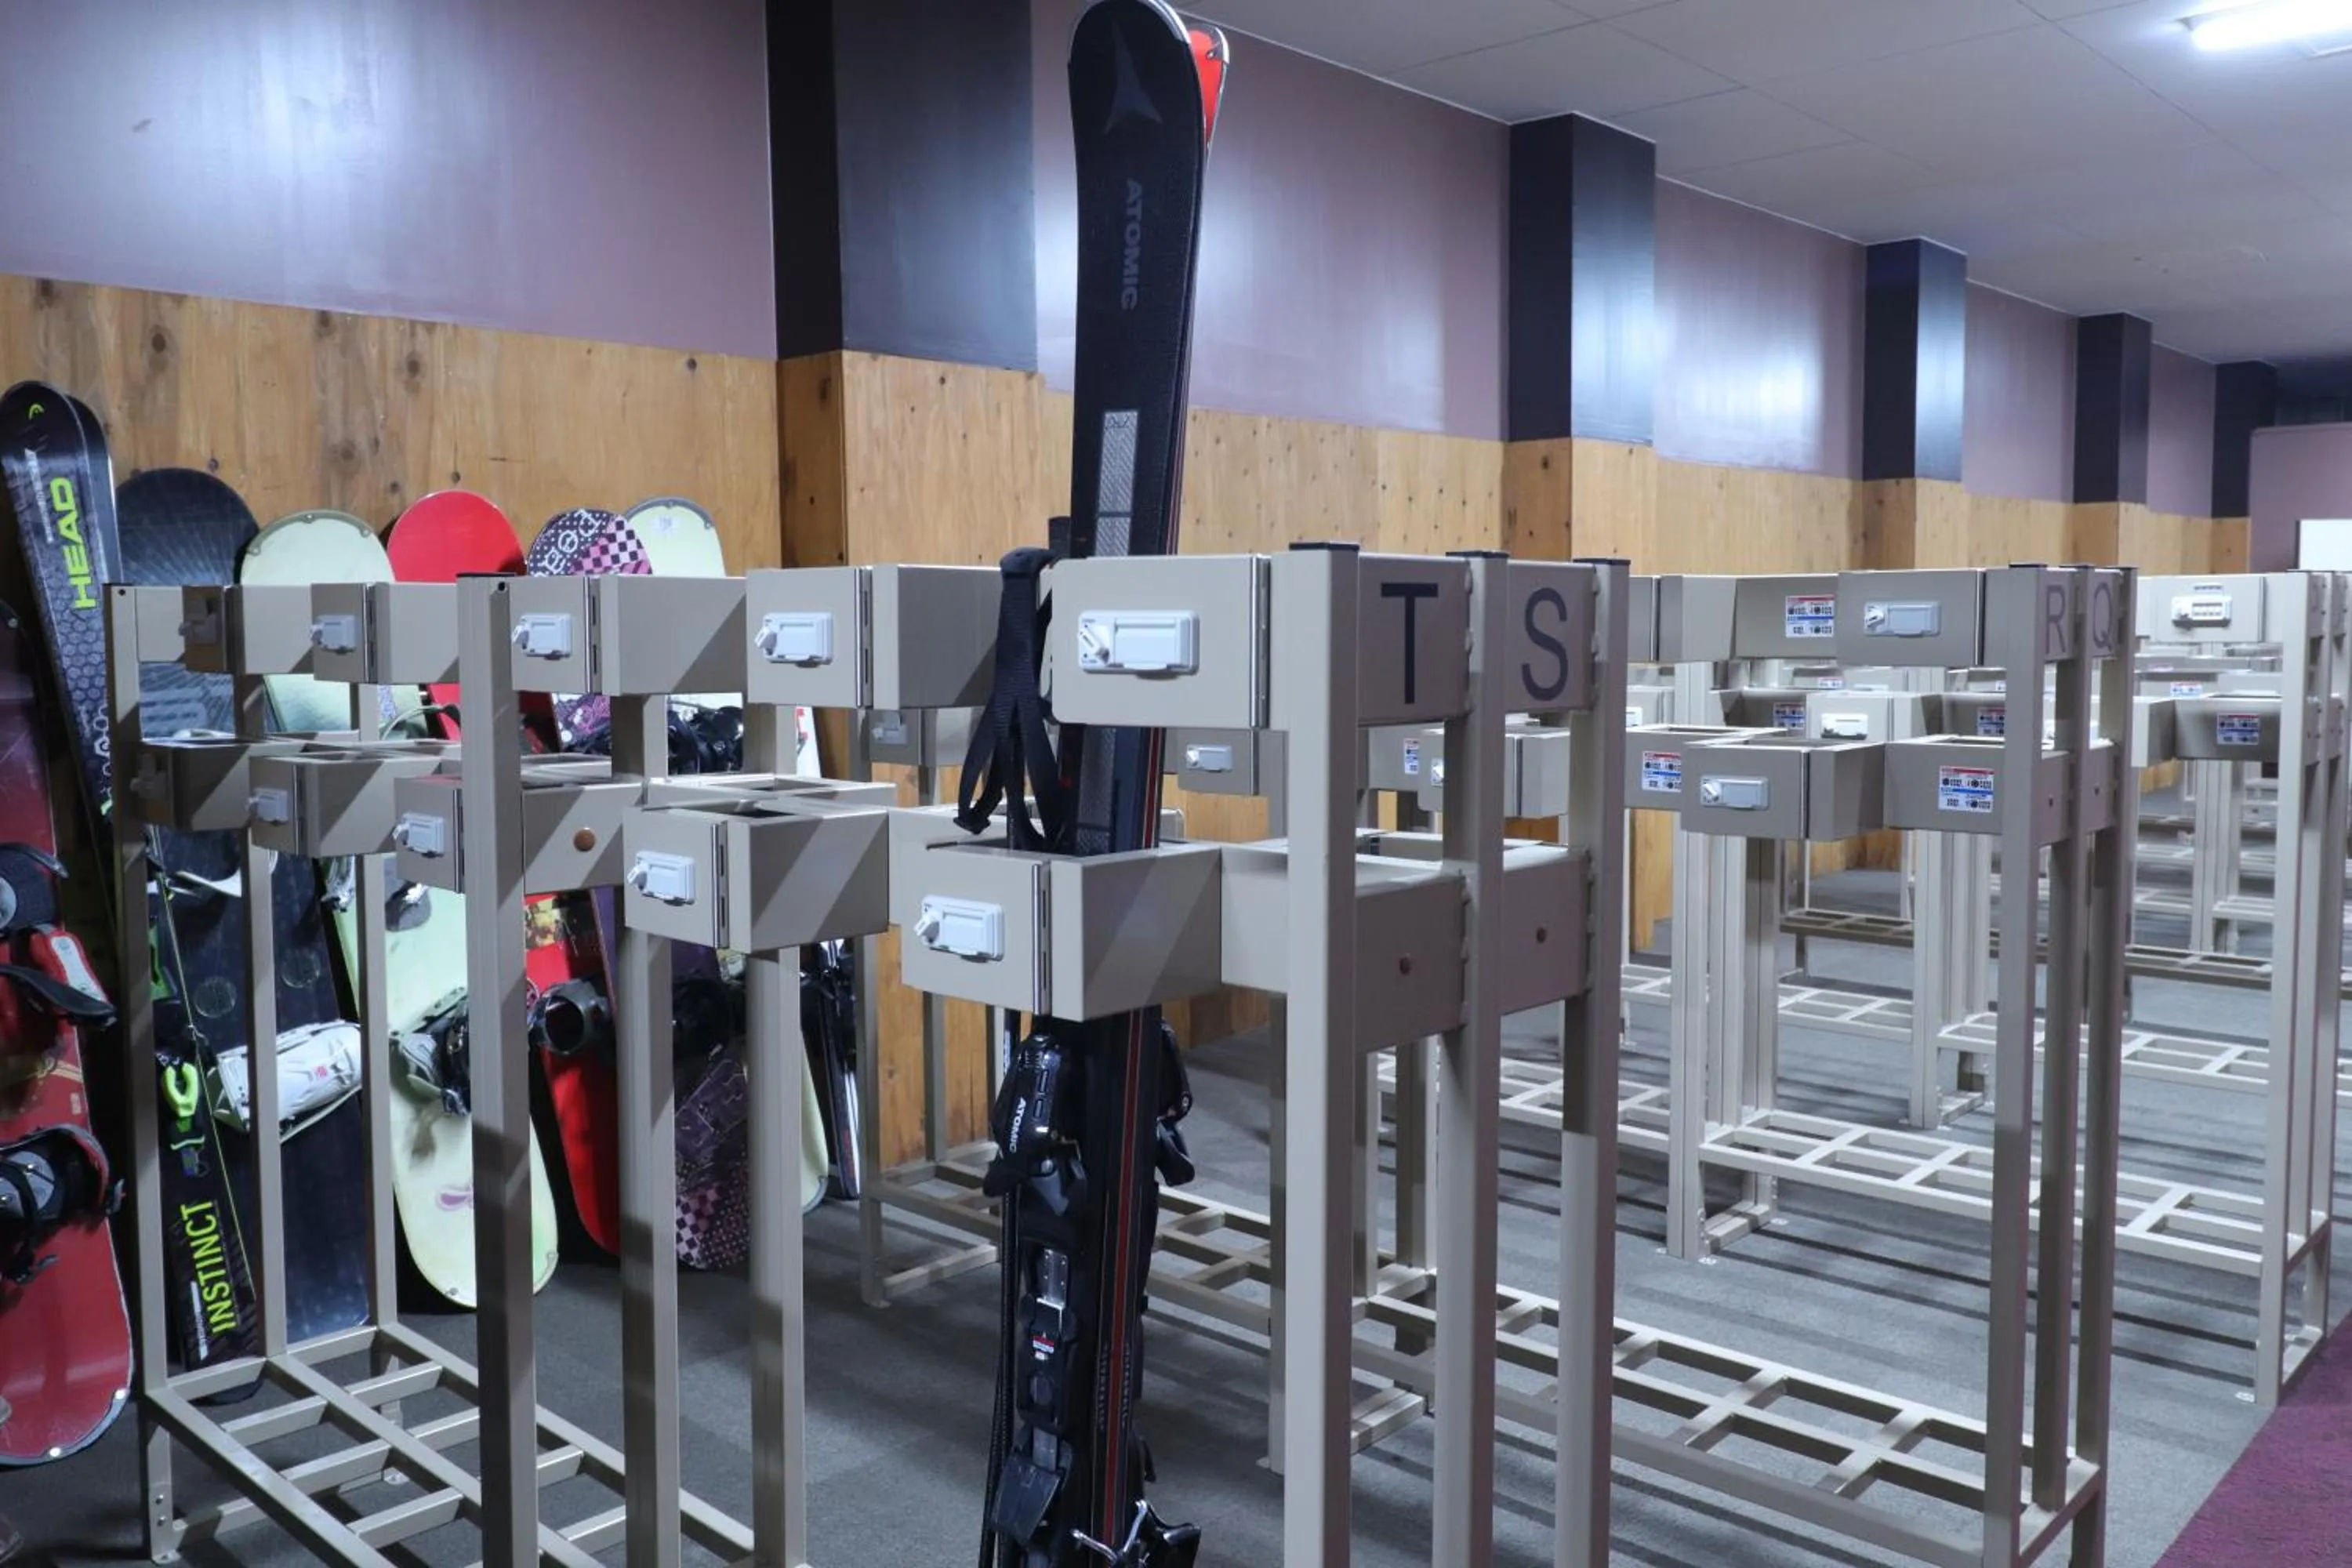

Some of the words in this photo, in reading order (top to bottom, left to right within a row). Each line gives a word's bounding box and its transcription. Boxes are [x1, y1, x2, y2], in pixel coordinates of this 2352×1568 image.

[1121, 178, 1142, 310] ATOMIC
[50, 477, 97, 609] HEAD
[1381, 583, 1439, 704] T
[1521, 587, 1568, 702] S
[2045, 585, 2066, 655] R
[2092, 582, 2113, 653] Q
[1009, 1097, 1027, 1153] ATOMIC
[180, 1201, 236, 1334] INSTINCT
